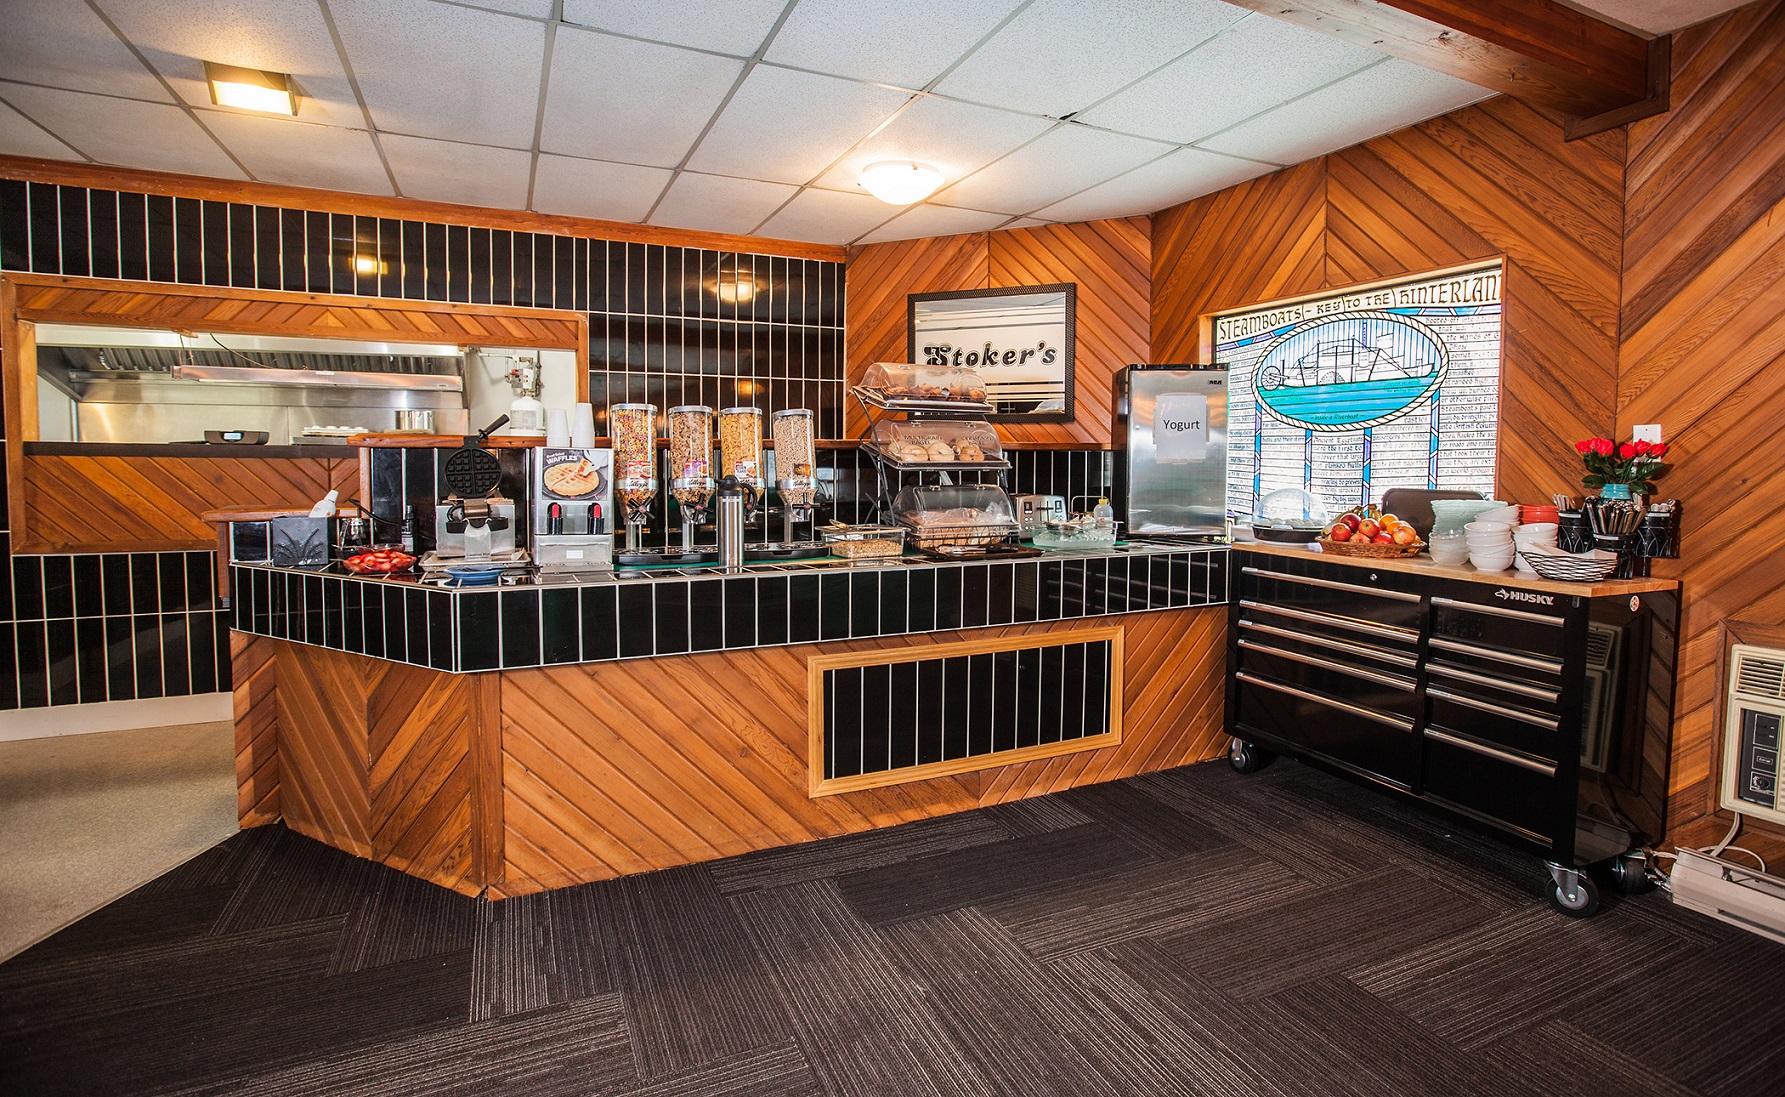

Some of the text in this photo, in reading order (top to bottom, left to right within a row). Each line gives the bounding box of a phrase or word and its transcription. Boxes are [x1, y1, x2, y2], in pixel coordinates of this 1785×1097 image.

[1219, 274, 1502, 340] STEAMBOATS KEY TO THE HINTERLAN
[923, 341, 1057, 369] Stoker's
[1163, 419, 1200, 432] Yogurt
[546, 455, 578, 464] WAFFLES
[1510, 592, 1554, 605] HUSKY
